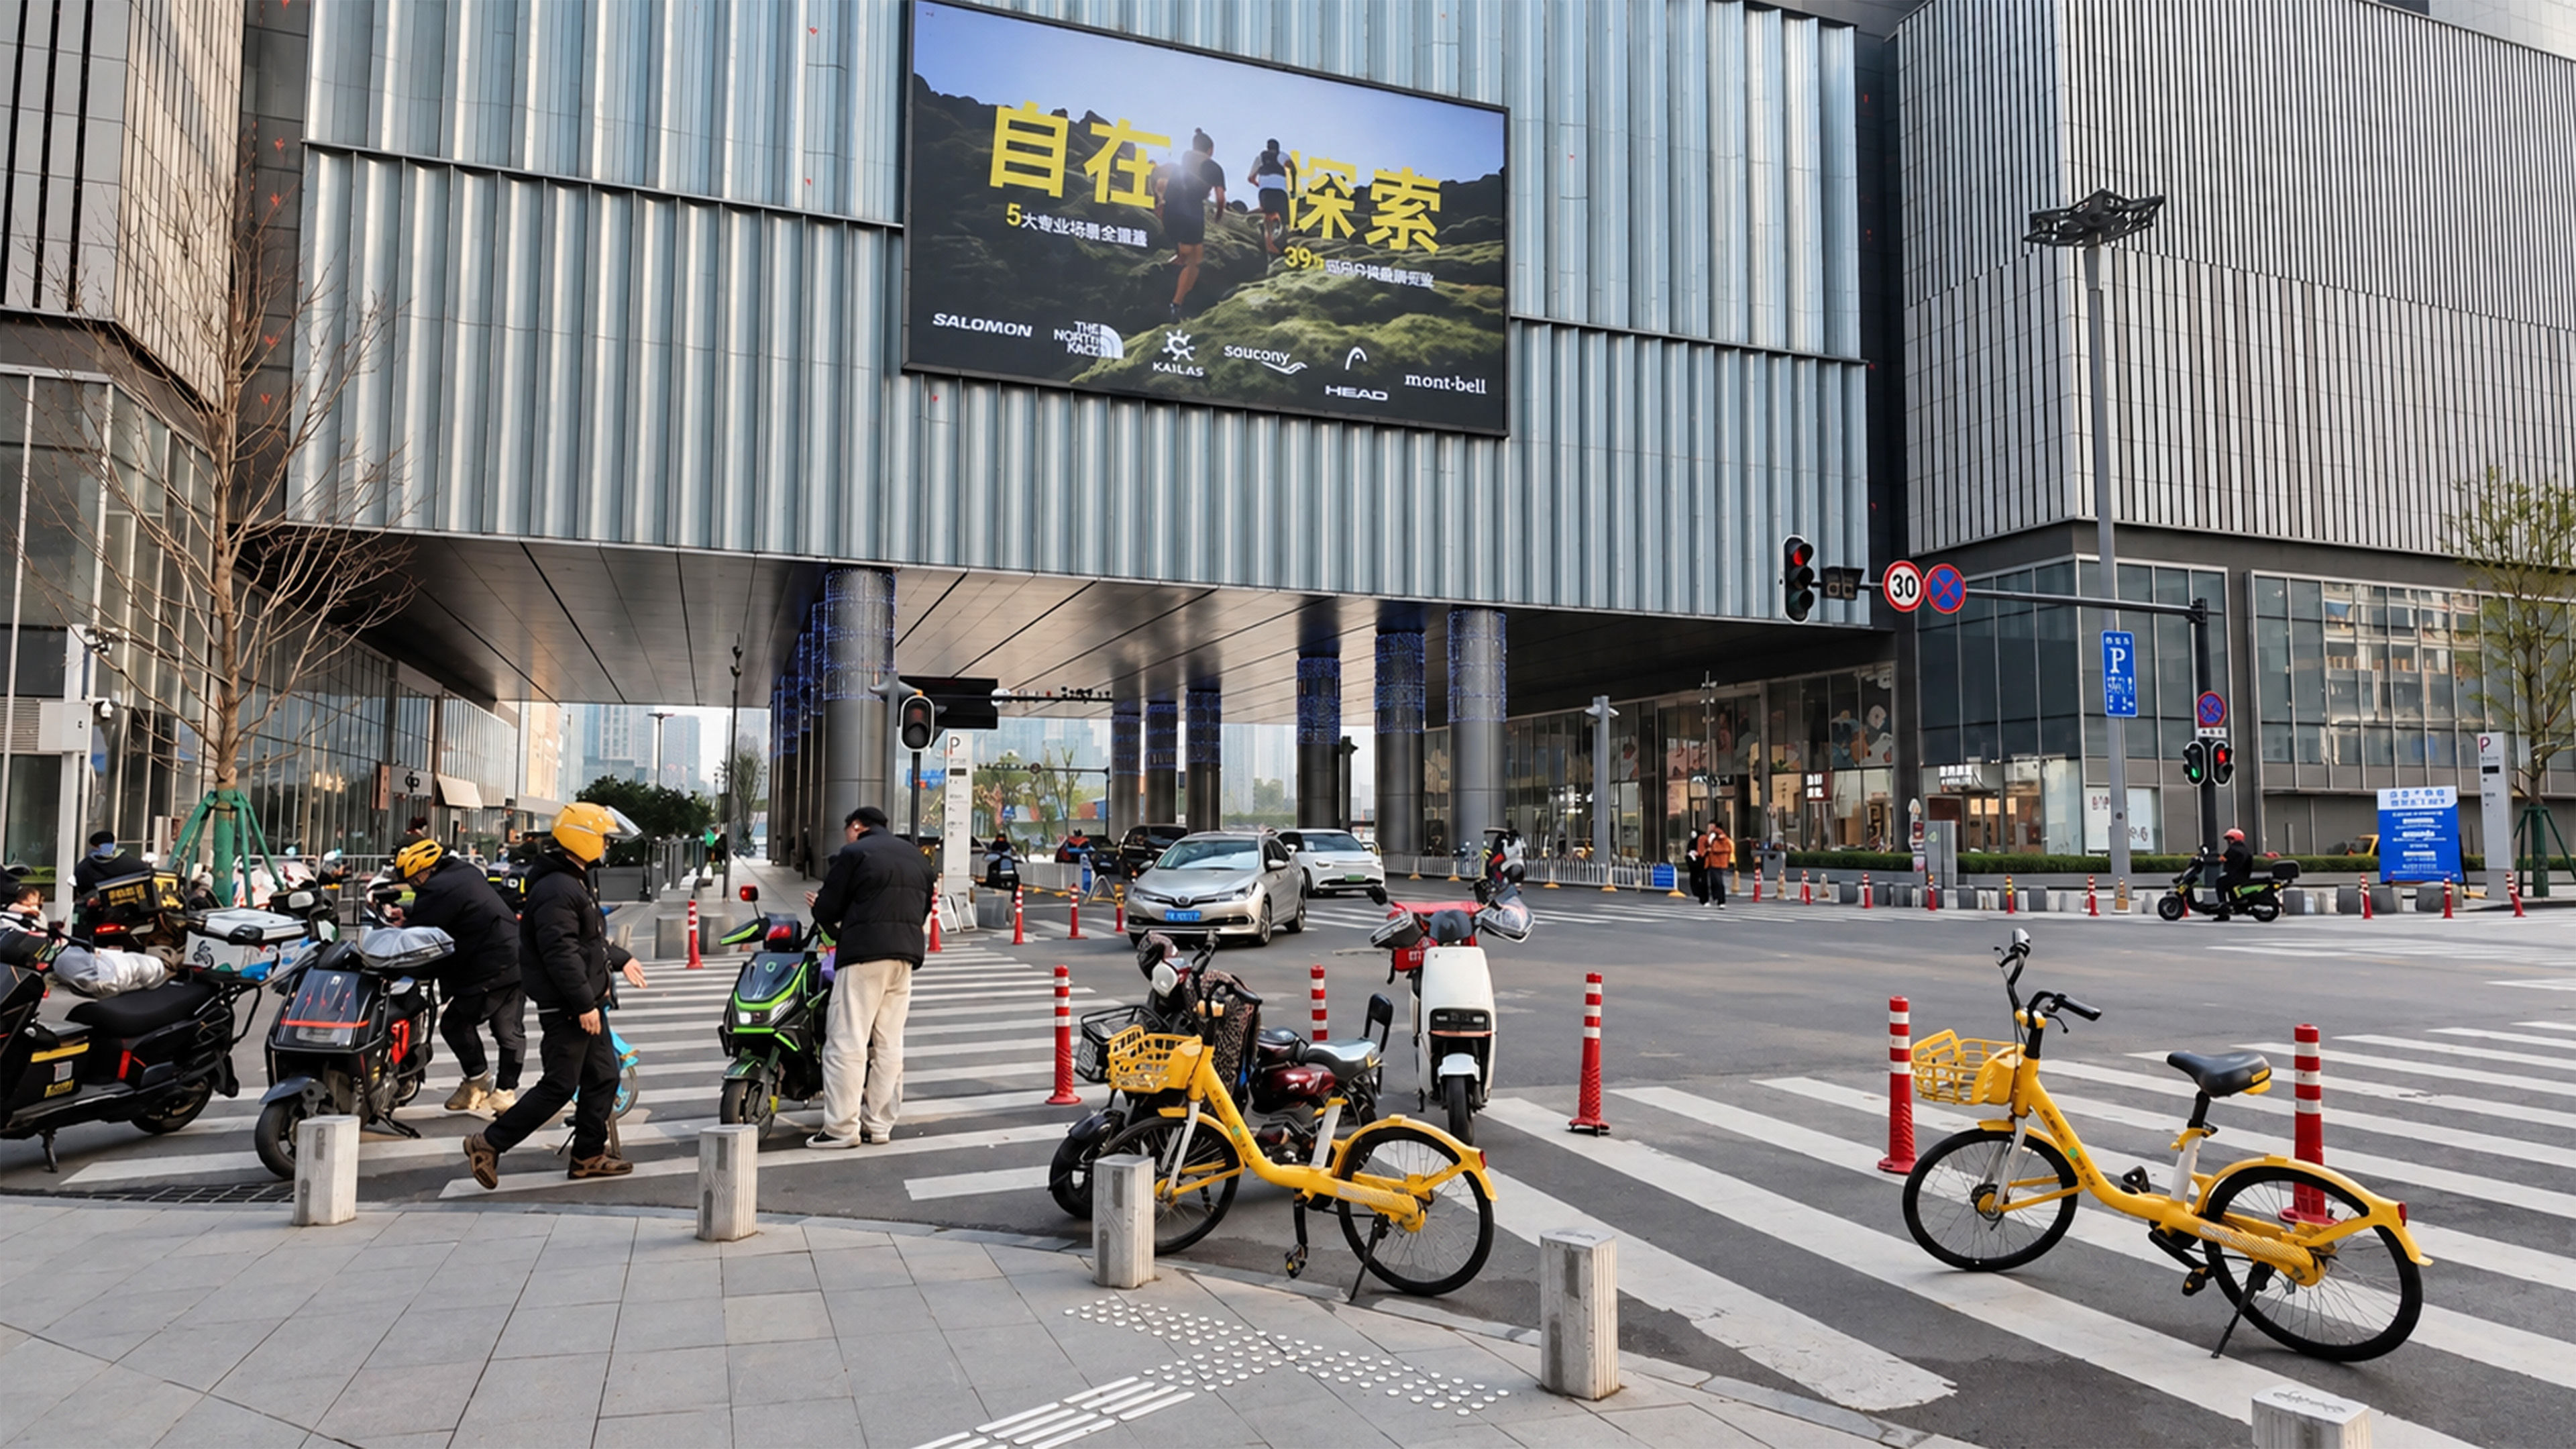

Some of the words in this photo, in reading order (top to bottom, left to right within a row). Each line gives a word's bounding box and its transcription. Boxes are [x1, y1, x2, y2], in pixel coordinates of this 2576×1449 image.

[989, 100, 1171, 209] 自在
[1286, 150, 1441, 254] 探索
[932, 313, 1032, 337] SALOMON
[1074, 321, 1099, 335] THE
[1224, 345, 1291, 366] saucony
[1152, 361, 1205, 378] KAILAS
[1325, 385, 1389, 400] HEAD
[1892, 574, 1917, 598] 30
[2109, 647, 2126, 674] P
